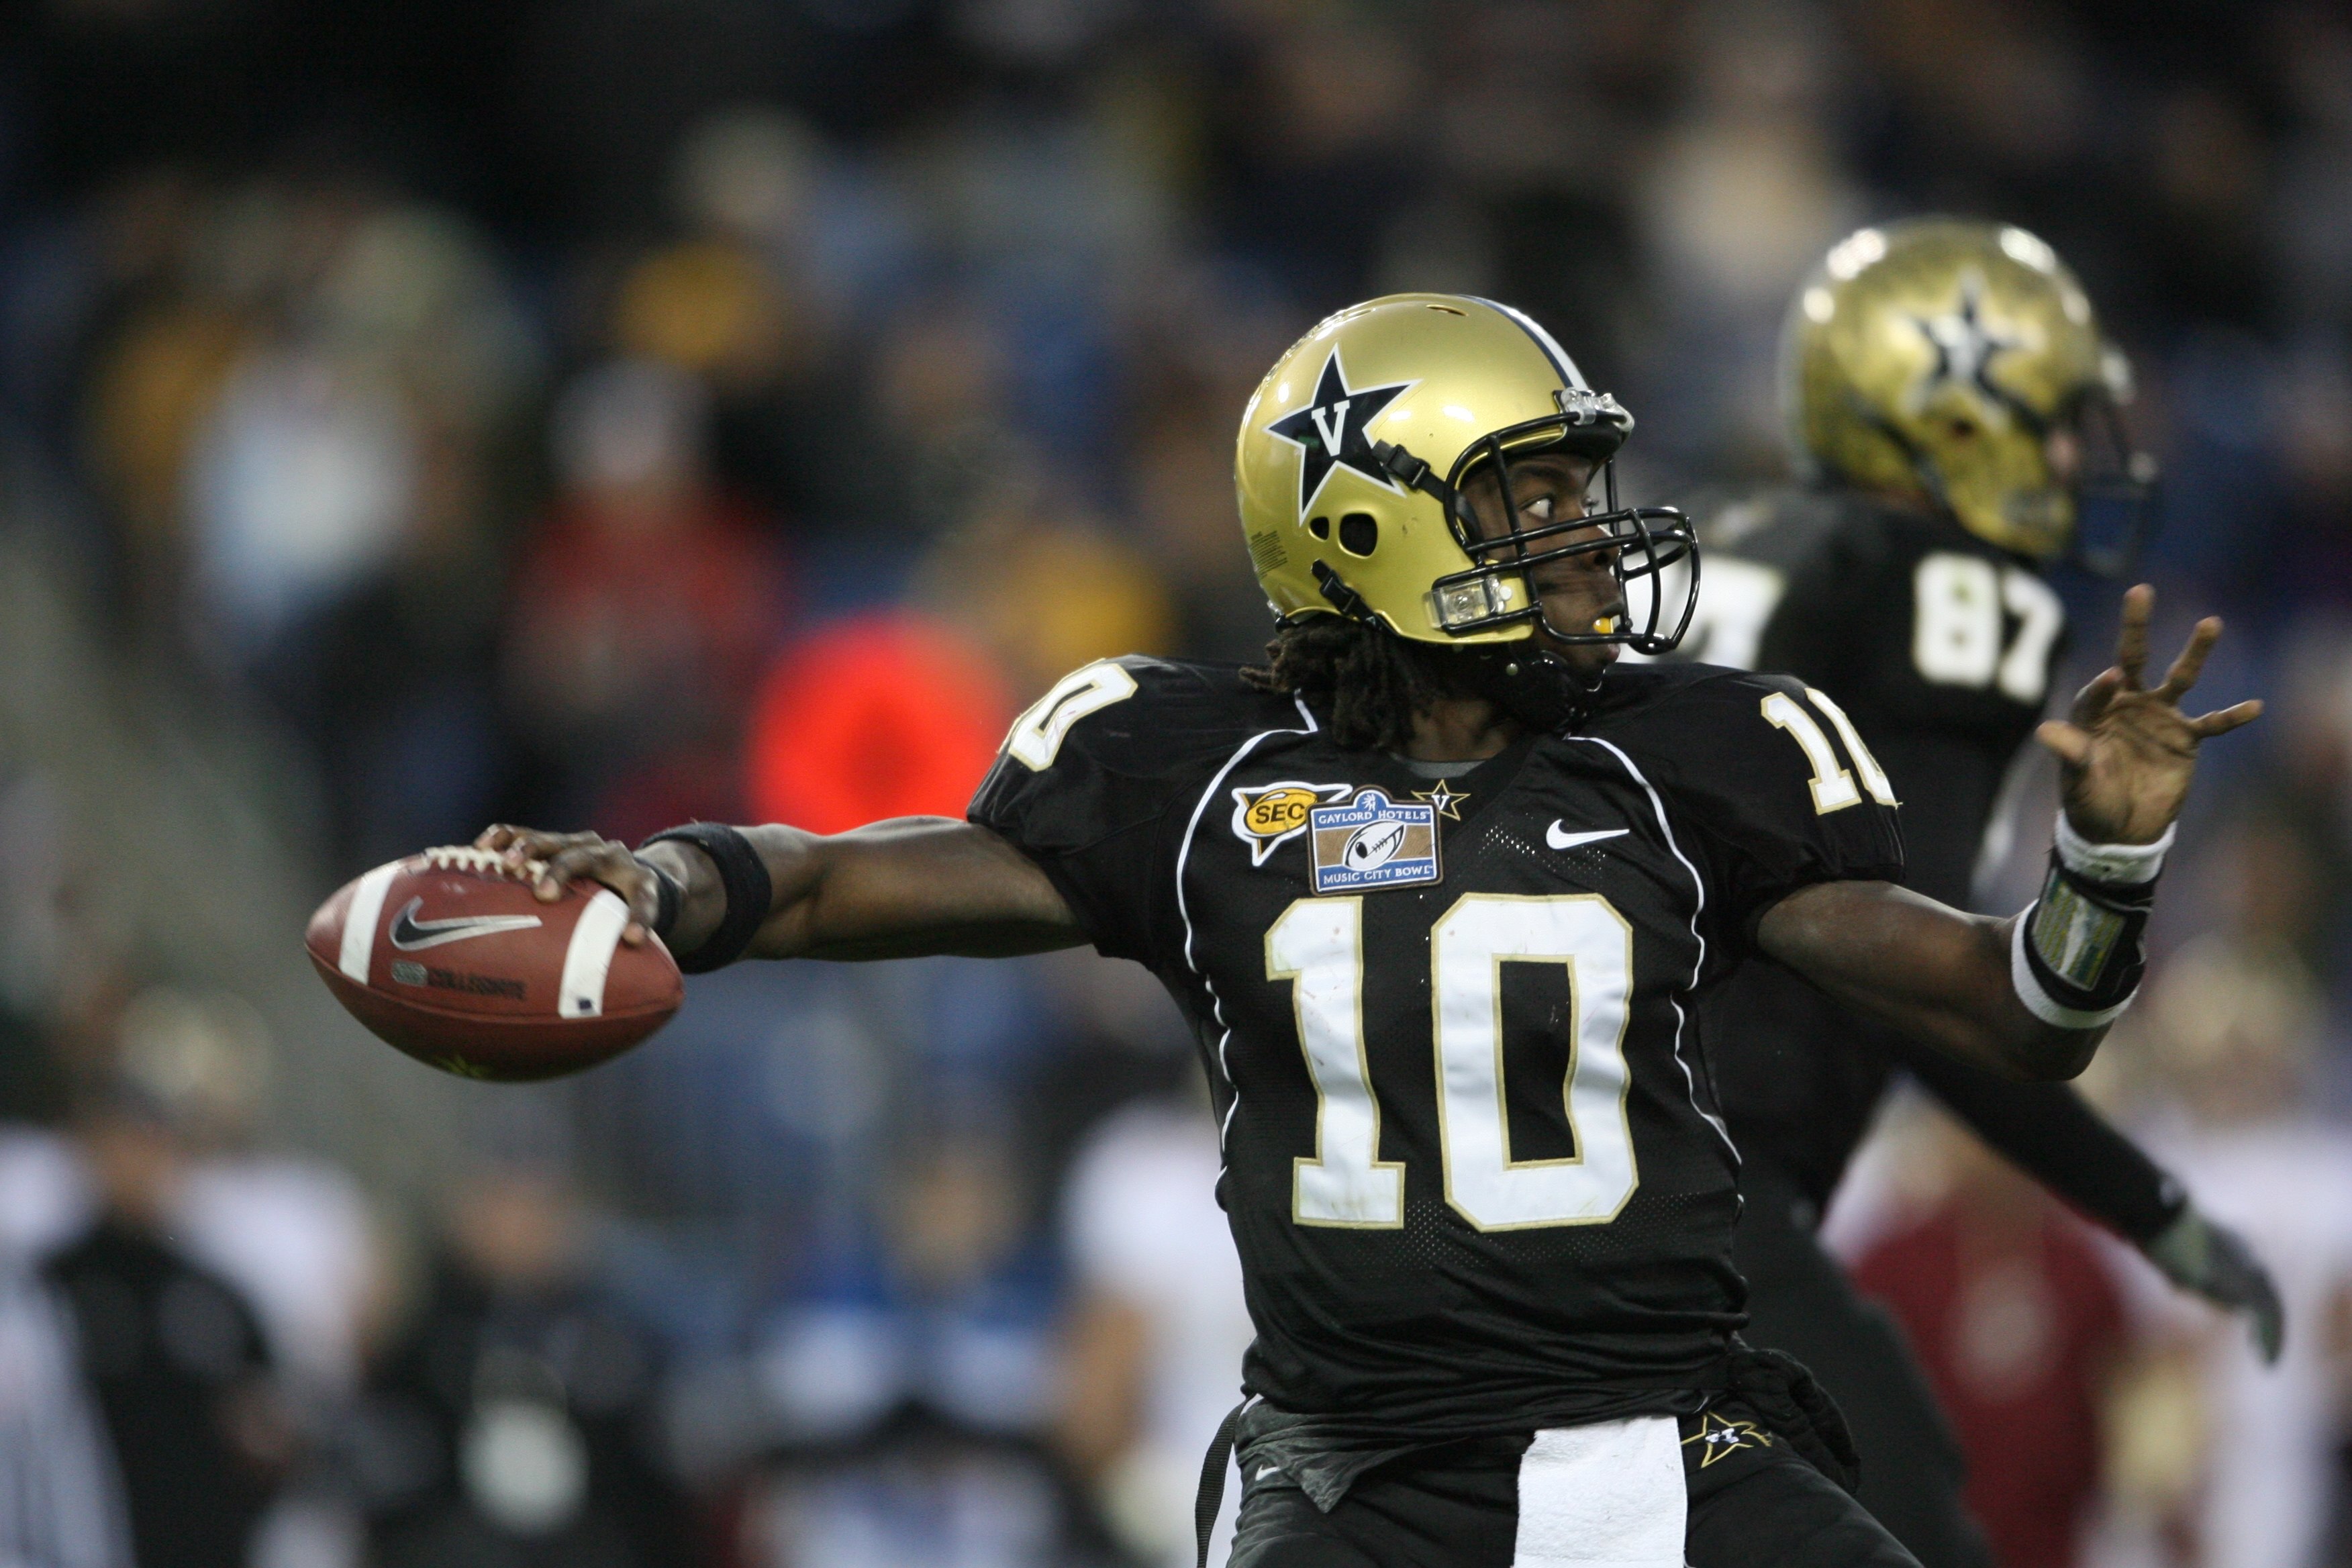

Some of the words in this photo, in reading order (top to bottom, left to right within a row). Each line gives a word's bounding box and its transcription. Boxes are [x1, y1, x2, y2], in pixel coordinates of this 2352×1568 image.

[1311, 400, 1350, 456] V
[1913, 550, 2065, 702] 87
[1255, 802, 1306, 825] SEC
[1431, 795, 1448, 811] V
[1318, 812, 1373, 824] GAYLORD
[1378, 810, 1427, 820] HOTELS
[1323, 873, 1360, 885] MUSIC
[1364, 869, 1391, 881] CITY
[1395, 866, 1430, 877] BOWL
[1264, 892, 1639, 1233] 10
